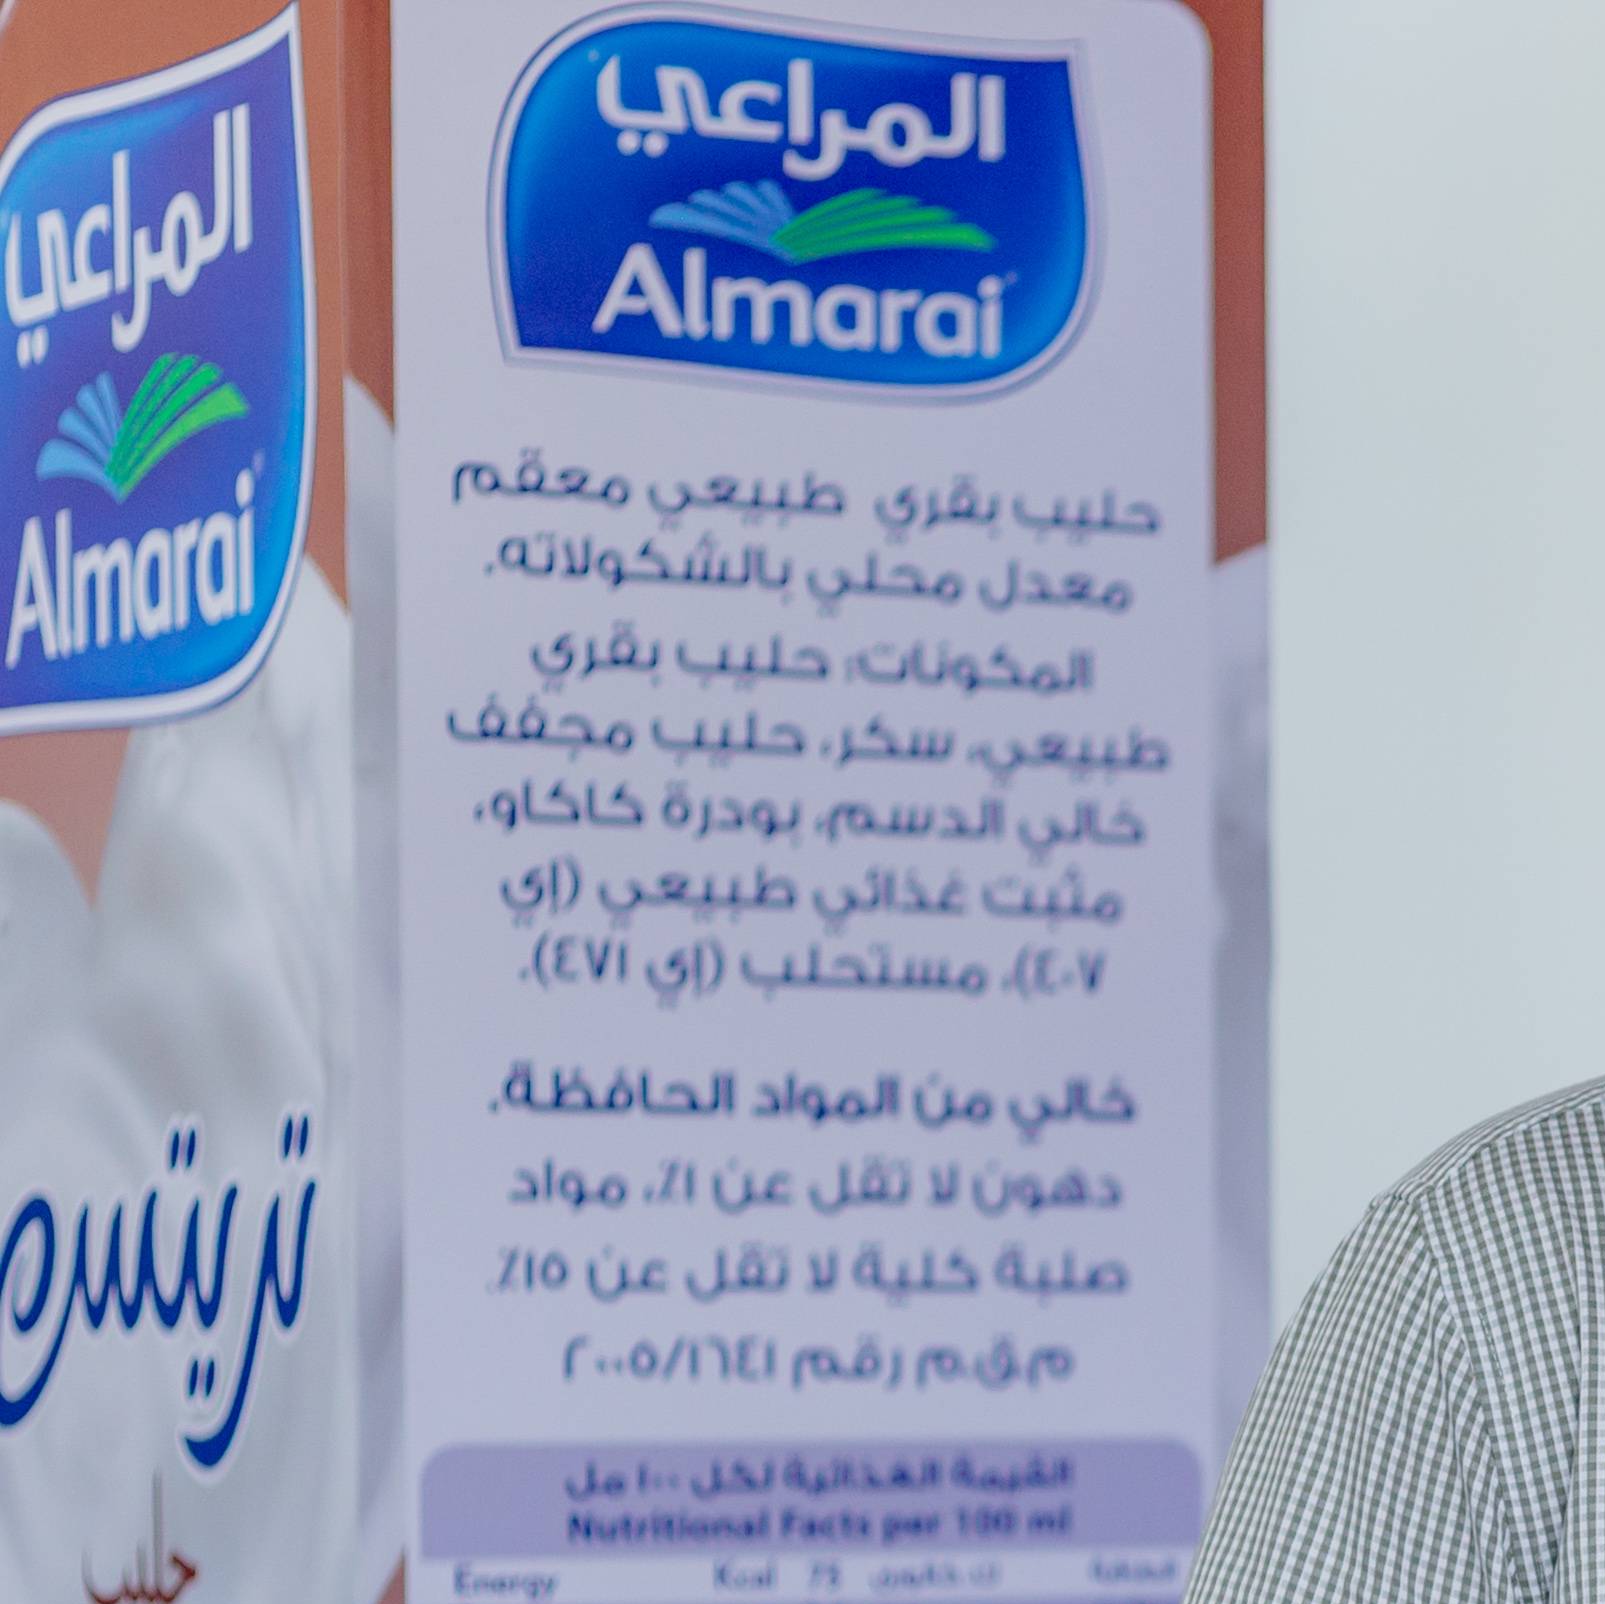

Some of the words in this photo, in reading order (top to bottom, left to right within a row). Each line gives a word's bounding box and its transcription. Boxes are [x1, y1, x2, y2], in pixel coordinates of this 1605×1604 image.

[594, 48, 1006, 182] المراعي
[4, 103, 251, 368] المراعي
[592, 244, 1004, 358] Almarai
[451, 448, 633, 510] معقم
[647, 472, 848, 530] طبيعي
[873, 475, 1000, 543] بقري
[1011, 491, 1162, 543] حليب
[5, 468, 255, 668] Almarai
[977, 561, 1134, 614] معدل
[529, 621, 662, 692] بقري
[675, 635, 830, 689] حليب
[651, 711, 807, 766] حليب
[1017, 801, 1147, 863] خالي
[596, 866, 799, 928] طبيعي
[912, 1075, 994, 1128] من
[566, 1508, 773, 1546] Nutritional
[781, 1505, 872, 1543] Facts
[882, 1508, 943, 1544] per
